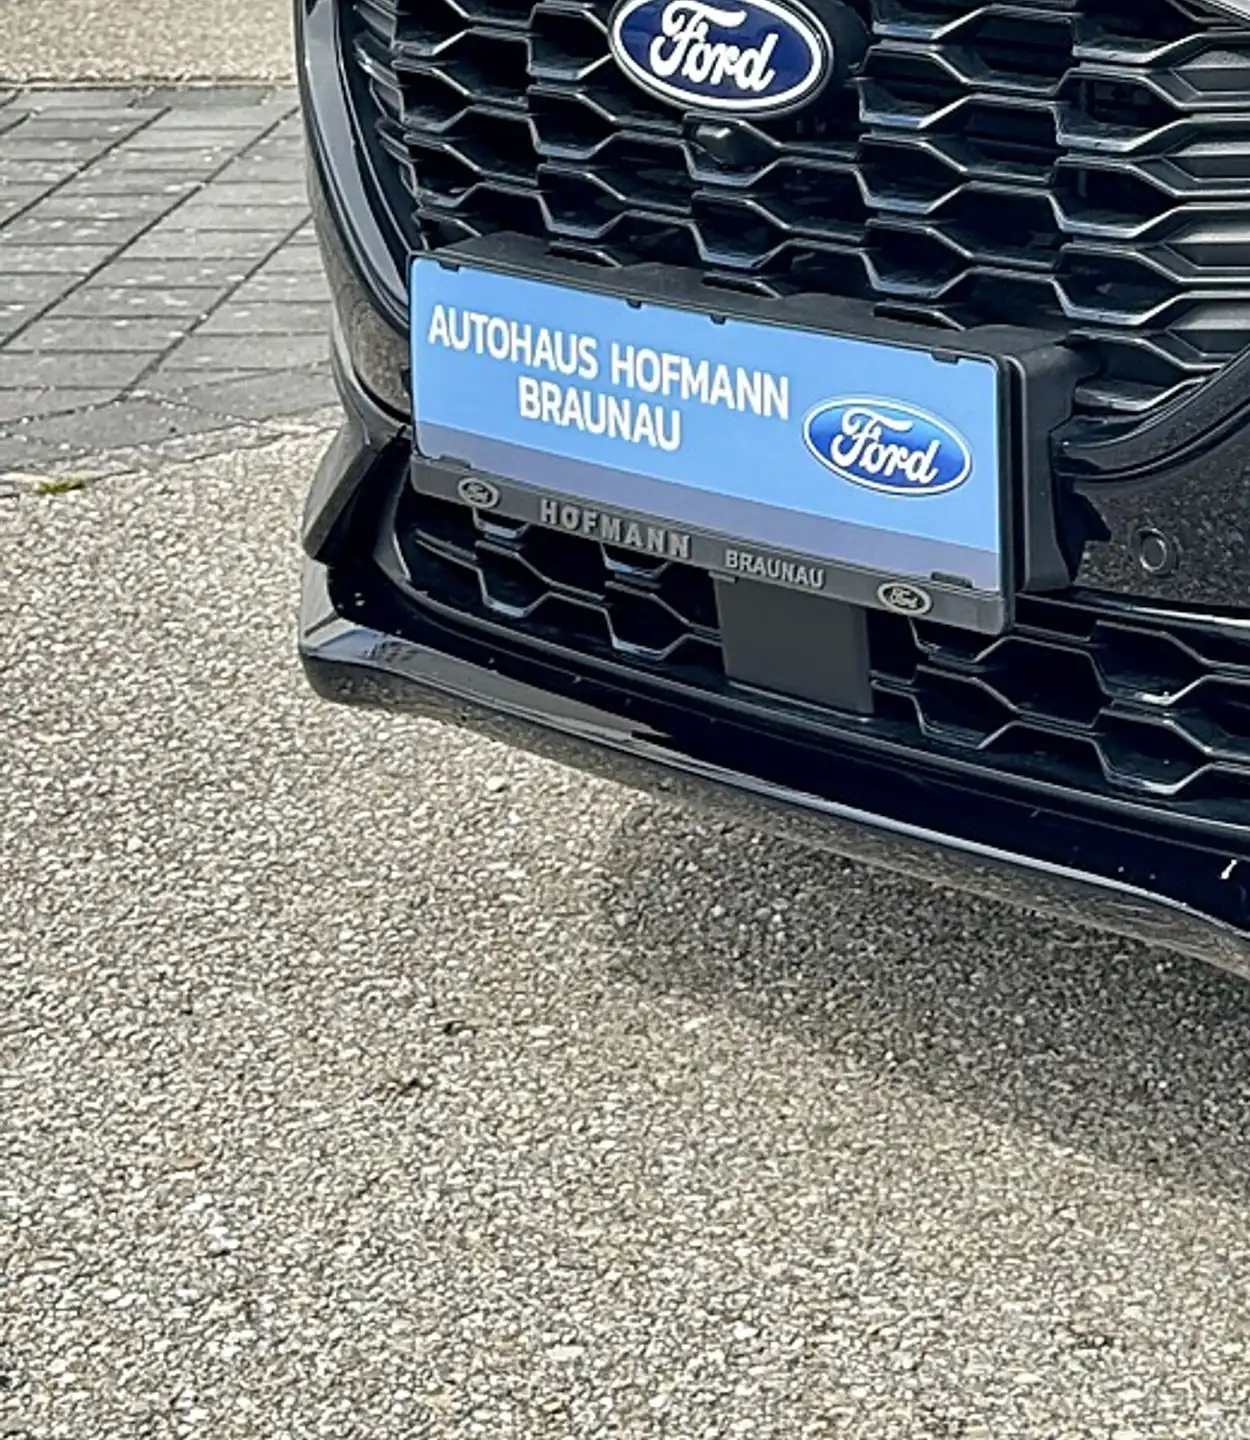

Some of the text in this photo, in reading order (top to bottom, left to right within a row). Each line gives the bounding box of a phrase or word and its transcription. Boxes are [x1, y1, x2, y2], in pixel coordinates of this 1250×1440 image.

[650, 0, 779, 92] Ford
[429, 304, 790, 421] AUTOHAUS HOFMANN
[519, 377, 682, 452] BRAUNAU
[829, 406, 940, 486] Ford
[539, 498, 691, 559] HOFMANN
[724, 549, 825, 588] BRAUNAU
